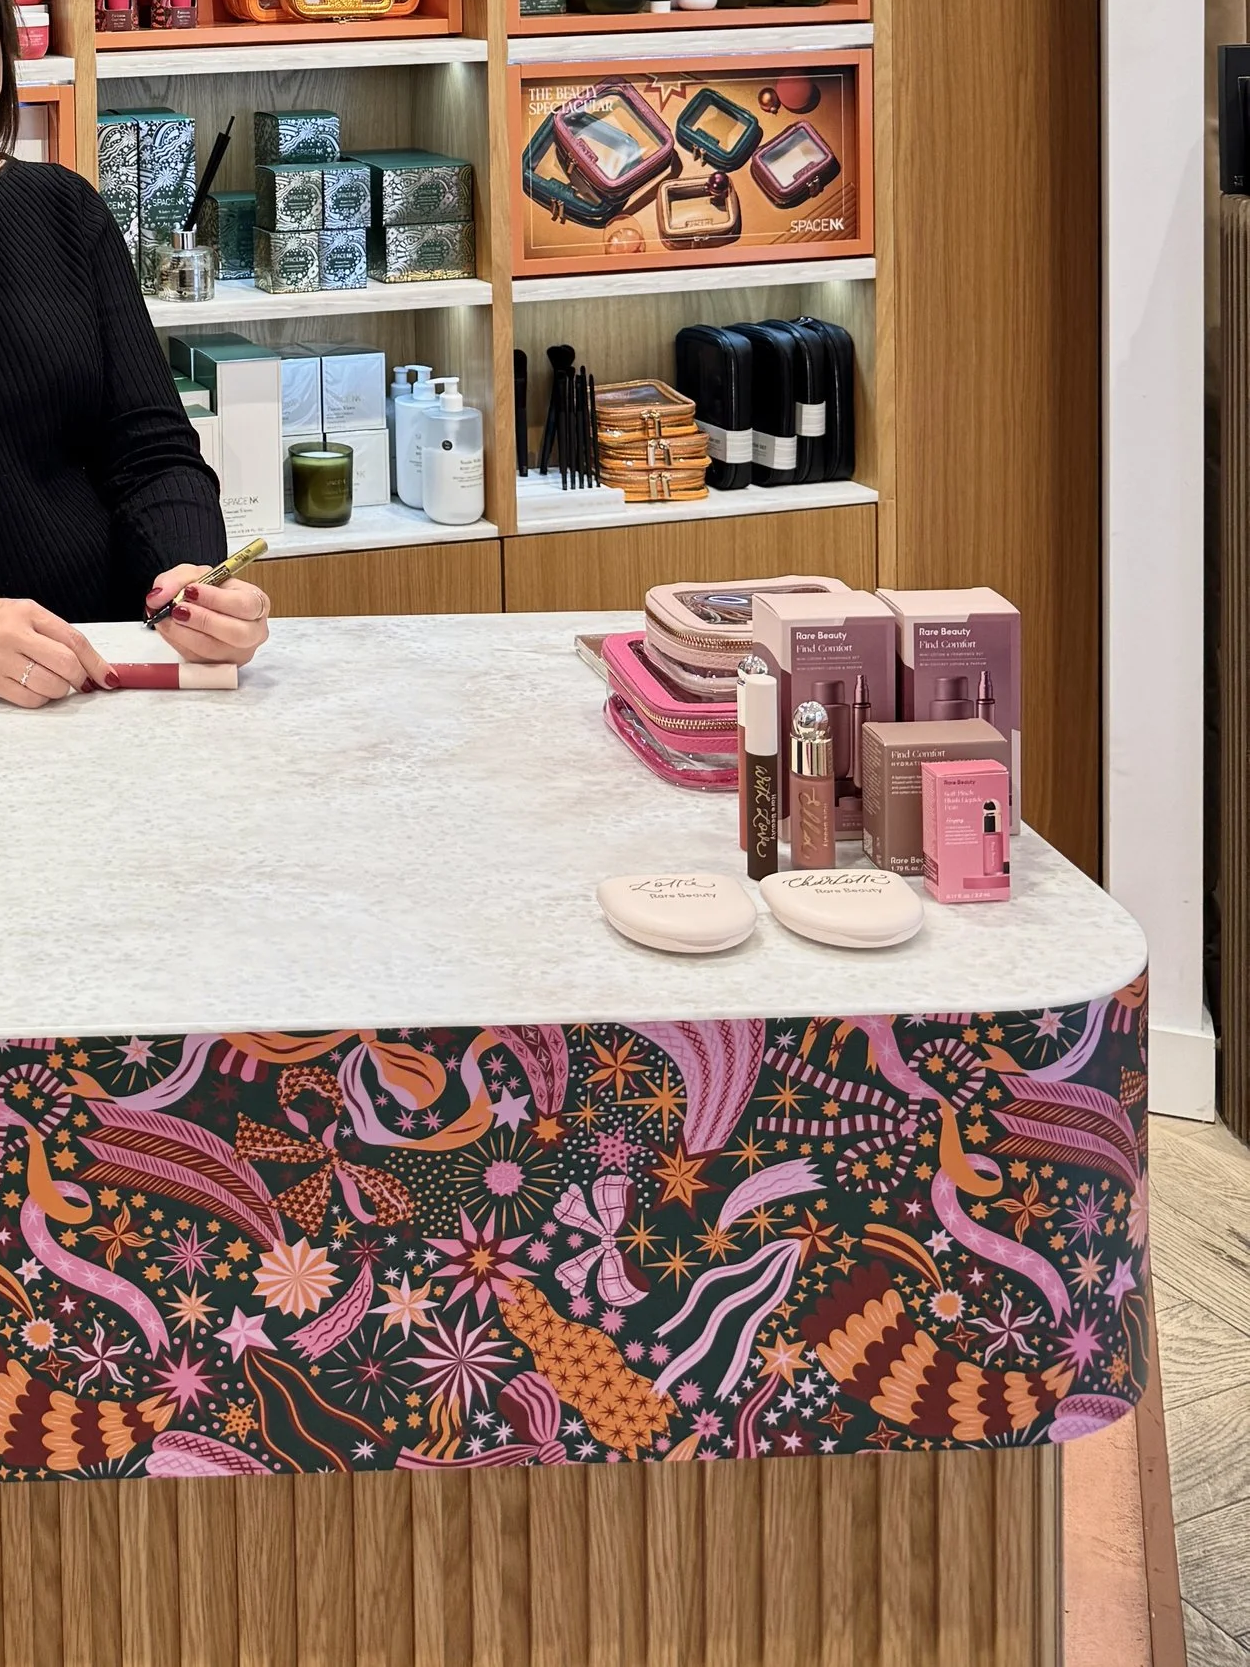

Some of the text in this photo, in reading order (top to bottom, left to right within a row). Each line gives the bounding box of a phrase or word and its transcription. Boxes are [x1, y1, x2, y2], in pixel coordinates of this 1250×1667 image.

[529, 85, 597, 101] THE BEAUTY
[529, 100, 614, 115] SPECTACULAR
[796, 631, 847, 641] Rare Beauty
[919, 627, 971, 637] Rare Beauty
[796, 642, 853, 653] Find Comfort
[919, 638, 976, 649] Find Comfort
[891, 748, 946, 759] Find Comfort
[752, 765, 772, 859] With Love
[890, 857, 908, 865] Rare
[782, 874, 891, 889] Charlotte
[677, 892, 717, 900] Beauty
[815, 886, 883, 895] Rare Beauty
